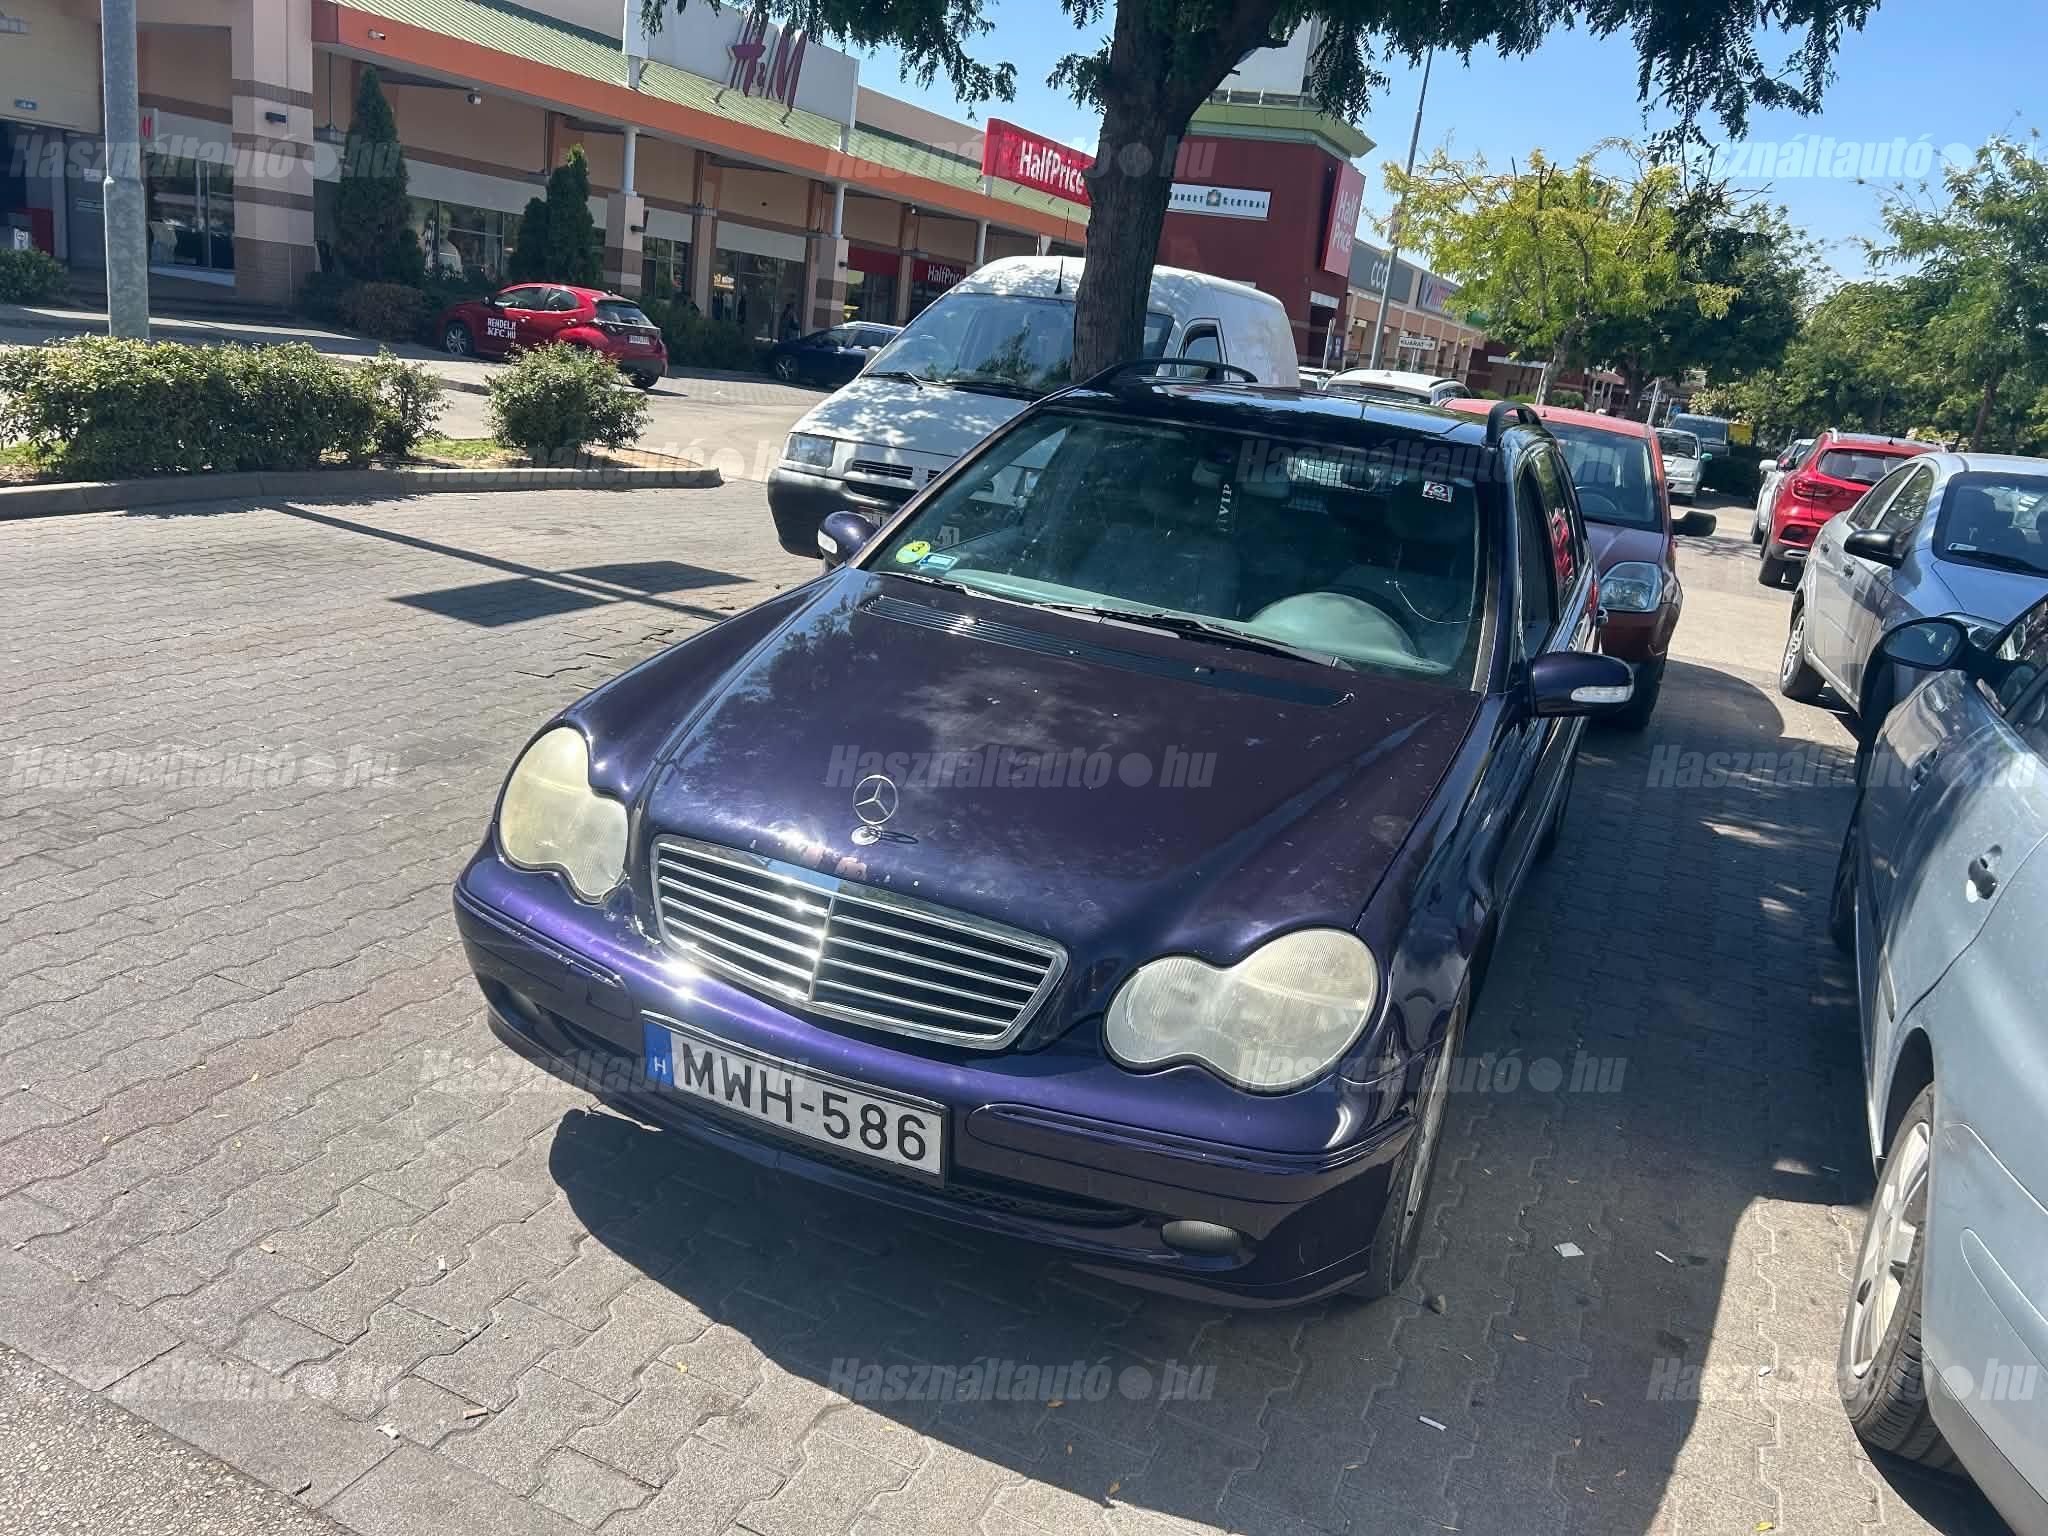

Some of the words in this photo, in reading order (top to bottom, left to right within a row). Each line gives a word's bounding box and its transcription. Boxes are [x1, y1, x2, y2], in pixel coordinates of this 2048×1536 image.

[730, 8, 808, 112] H&M
[1019, 140, 1084, 195] HalfPrice
[1174, 193, 1204, 204] ARKET
[1337, 189, 1359, 225] Half
[487, 328, 516, 340] KFC.HU
[653, 1059, 666, 1075] H
[682, 1042, 926, 1161] MWH-586
